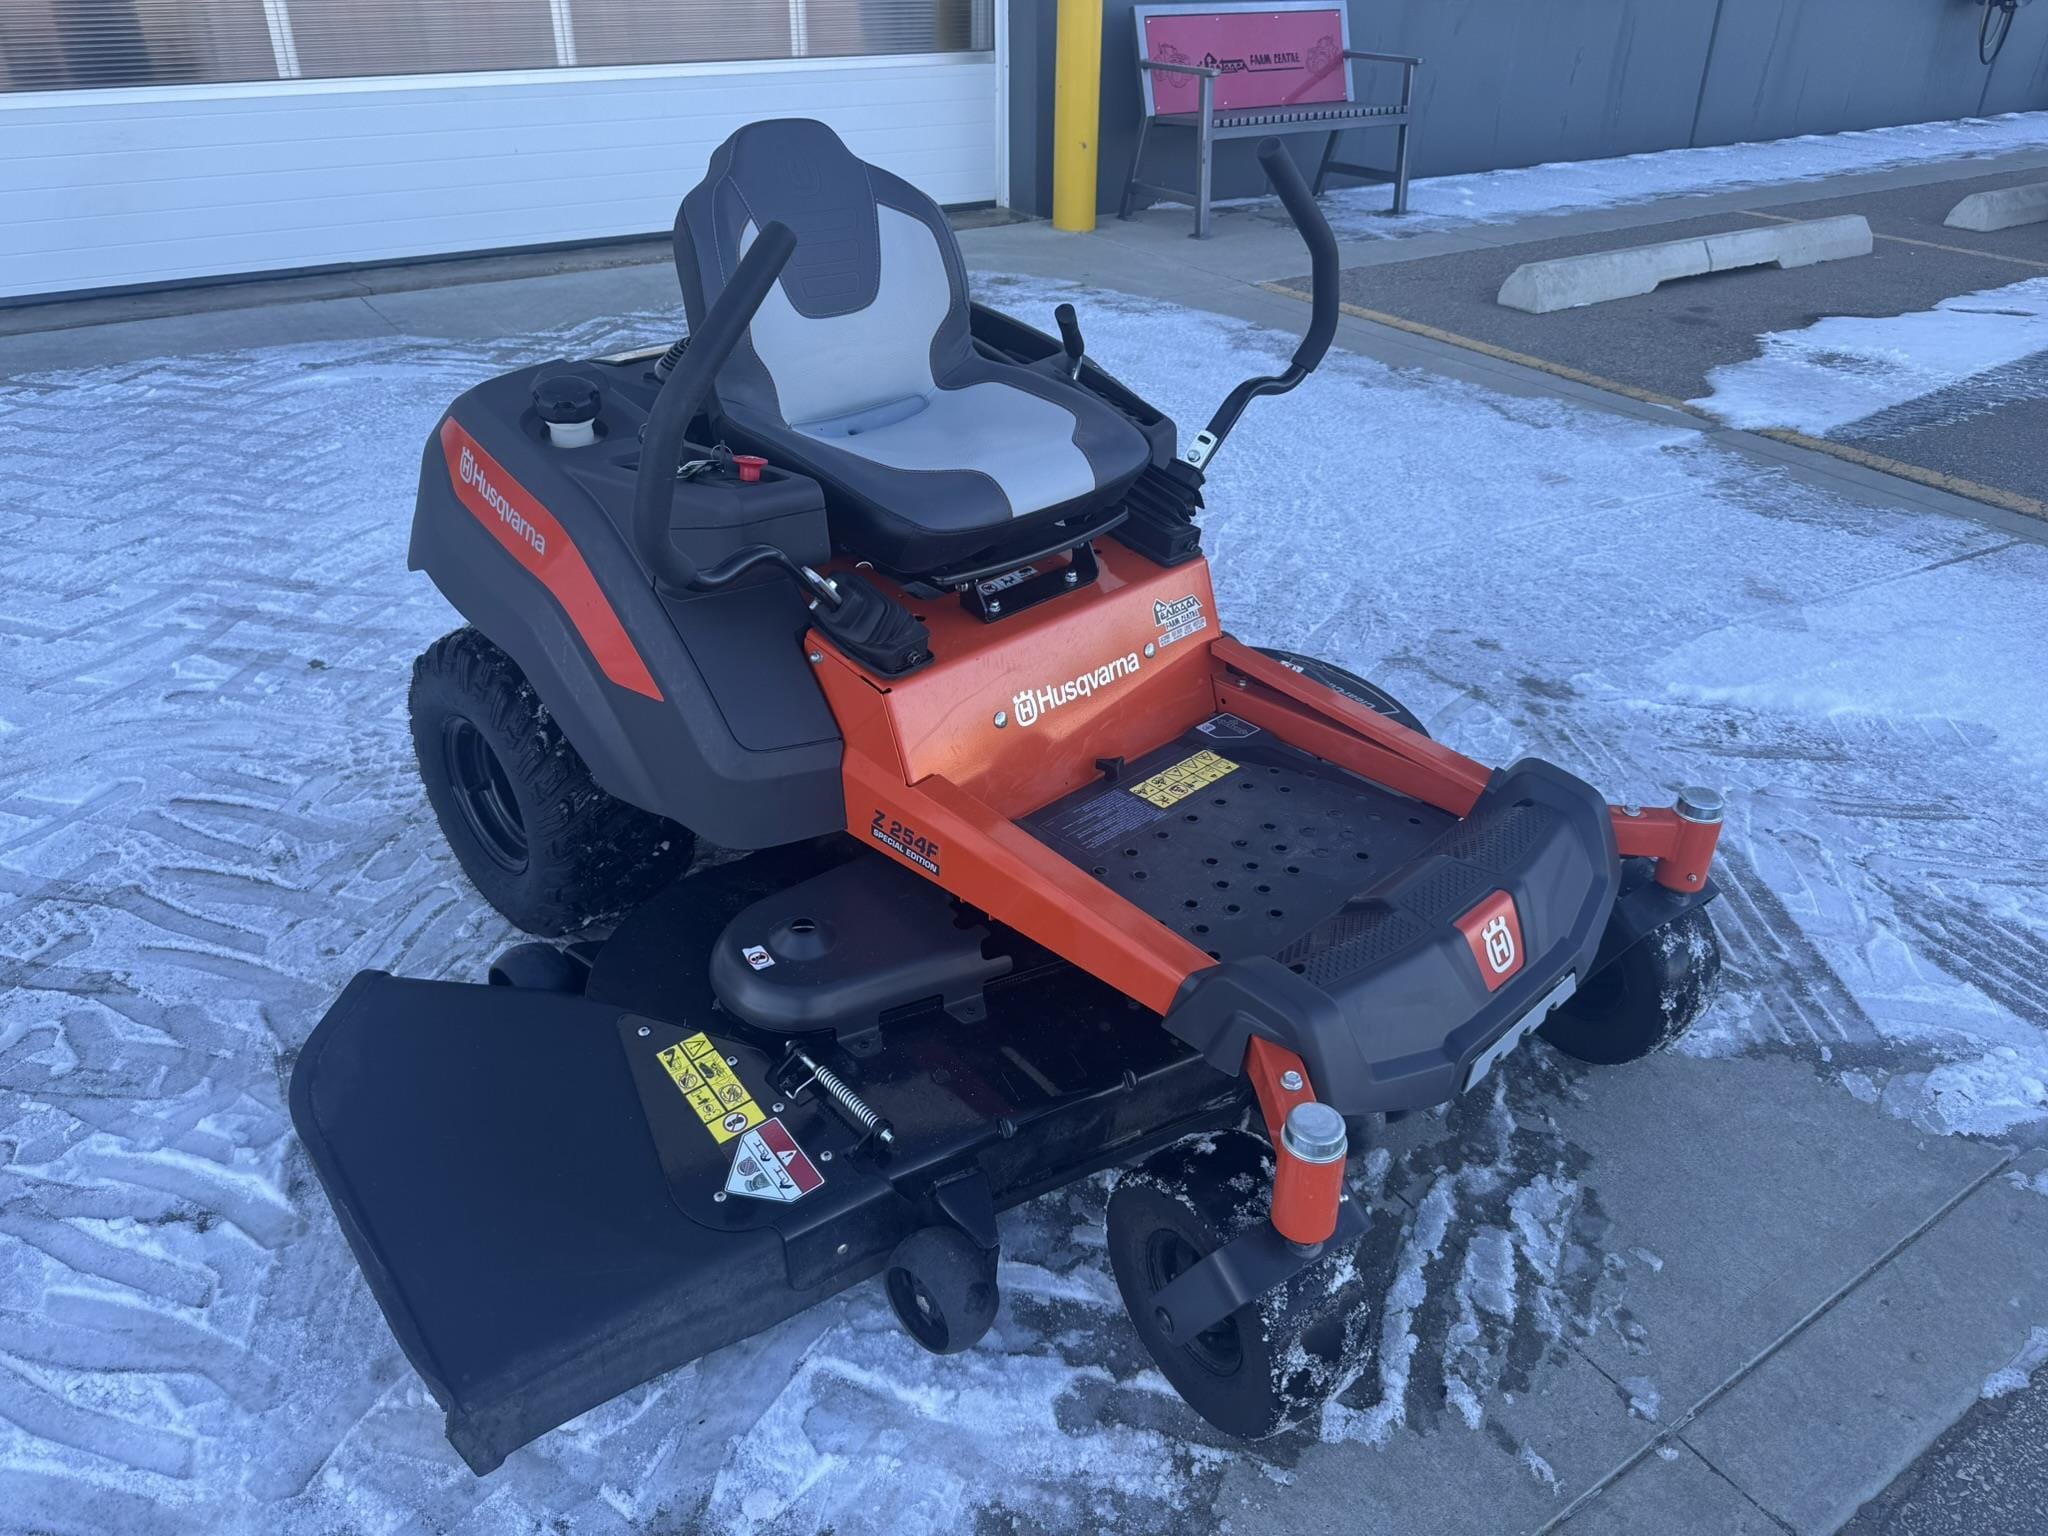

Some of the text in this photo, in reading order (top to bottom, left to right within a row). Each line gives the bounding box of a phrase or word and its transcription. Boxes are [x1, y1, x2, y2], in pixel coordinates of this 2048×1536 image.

[472, 463, 546, 555] Husqvarna
[1036, 652, 1140, 714] Husqvarna
[872, 809, 939, 858] Z 254F
[873, 828, 938, 873] SPECIAL EDITION
